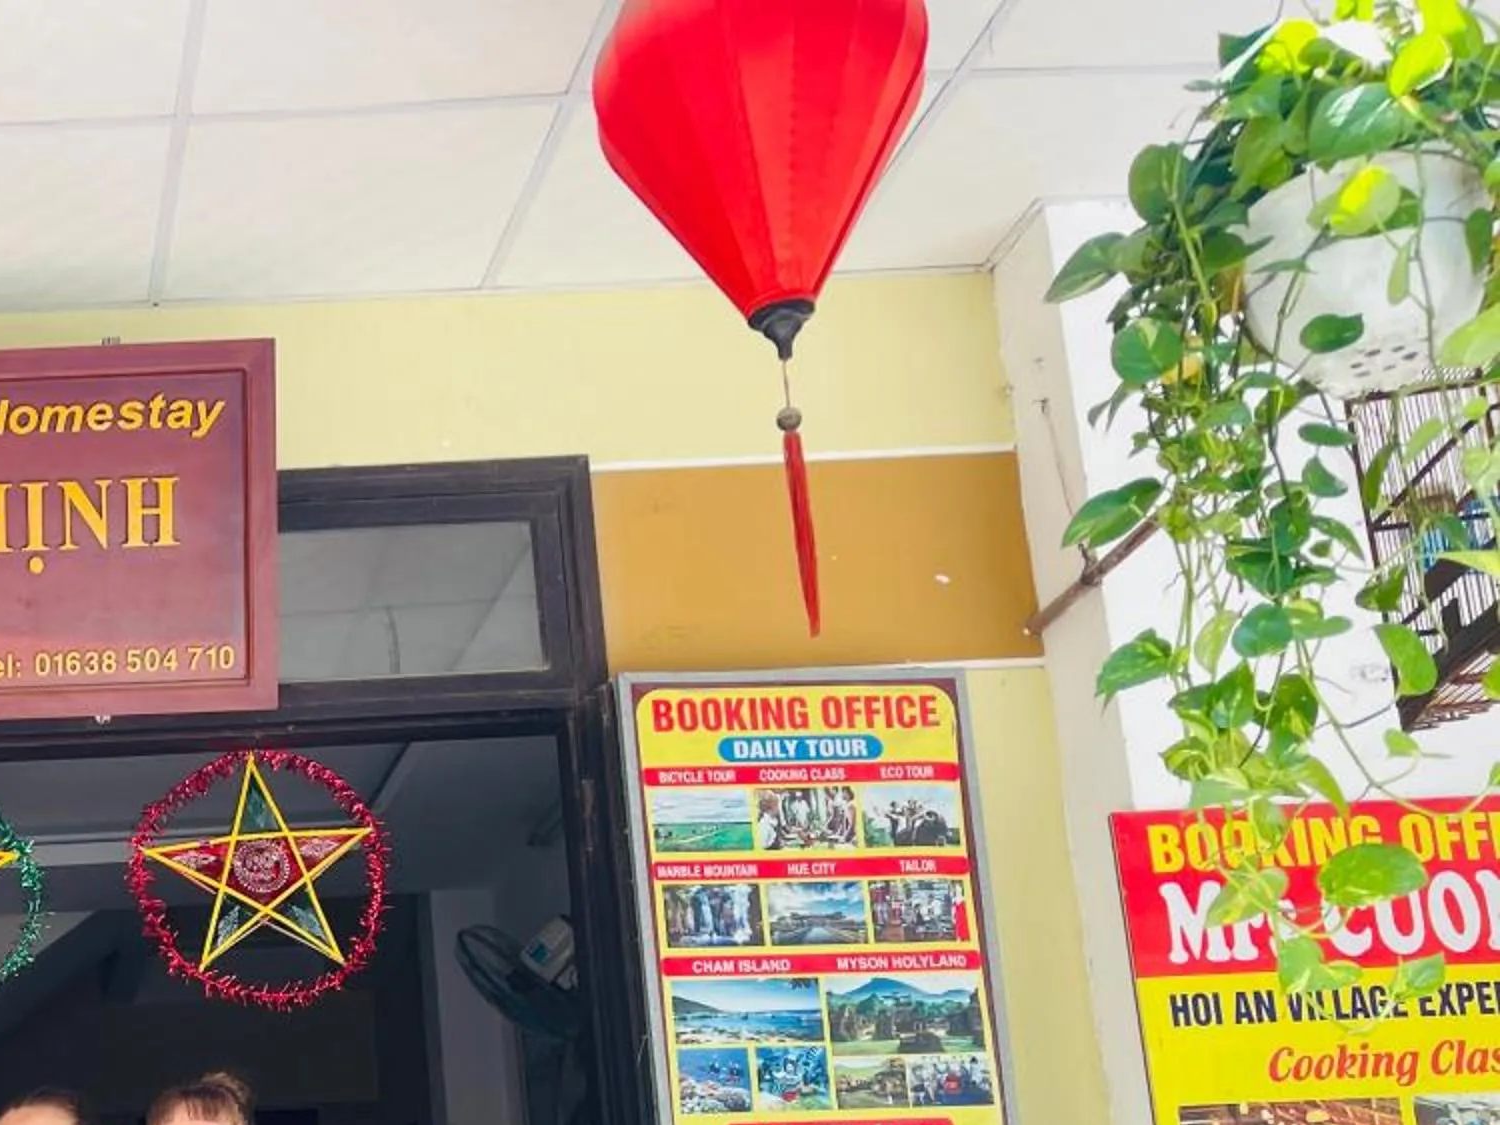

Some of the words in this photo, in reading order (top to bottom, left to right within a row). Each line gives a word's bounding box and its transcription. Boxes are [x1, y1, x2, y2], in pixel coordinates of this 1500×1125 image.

[35, 651, 118, 676] 01638
[126, 648, 179, 673] 504
[188, 645, 235, 670] 710
[652, 696, 810, 732] BOOKING
[821, 694, 941, 729] OFFICE
[733, 738, 799, 759] DAILY
[808, 737, 869, 758] TOUR
[659, 771, 705, 784] BICYCLE
[707, 770, 736, 783] TOUR
[759, 769, 808, 782] COOKING
[810, 768, 846, 781] CLASS
[880, 767, 905, 779] ECO
[906, 766, 934, 778] TOUR
[657, 865, 701, 877] MARBLE
[703, 864, 758, 876] MOUNTAIN
[787, 863, 809, 875] HUE
[811, 862, 836, 874] CITY
[900, 860, 936, 872] TAILOR
[692, 960, 737, 973] CHAM
[739, 958, 791, 972] ISLAND
[837, 956, 889, 970] MYSON
[892, 954, 967, 969] HOLYLAND
[1170, 992, 1223, 1027] HOI
[1235, 989, 1277, 1025] AN
[1418, 981, 1500, 1017] EXPE
[1269, 1042, 1419, 1087] Cooking
